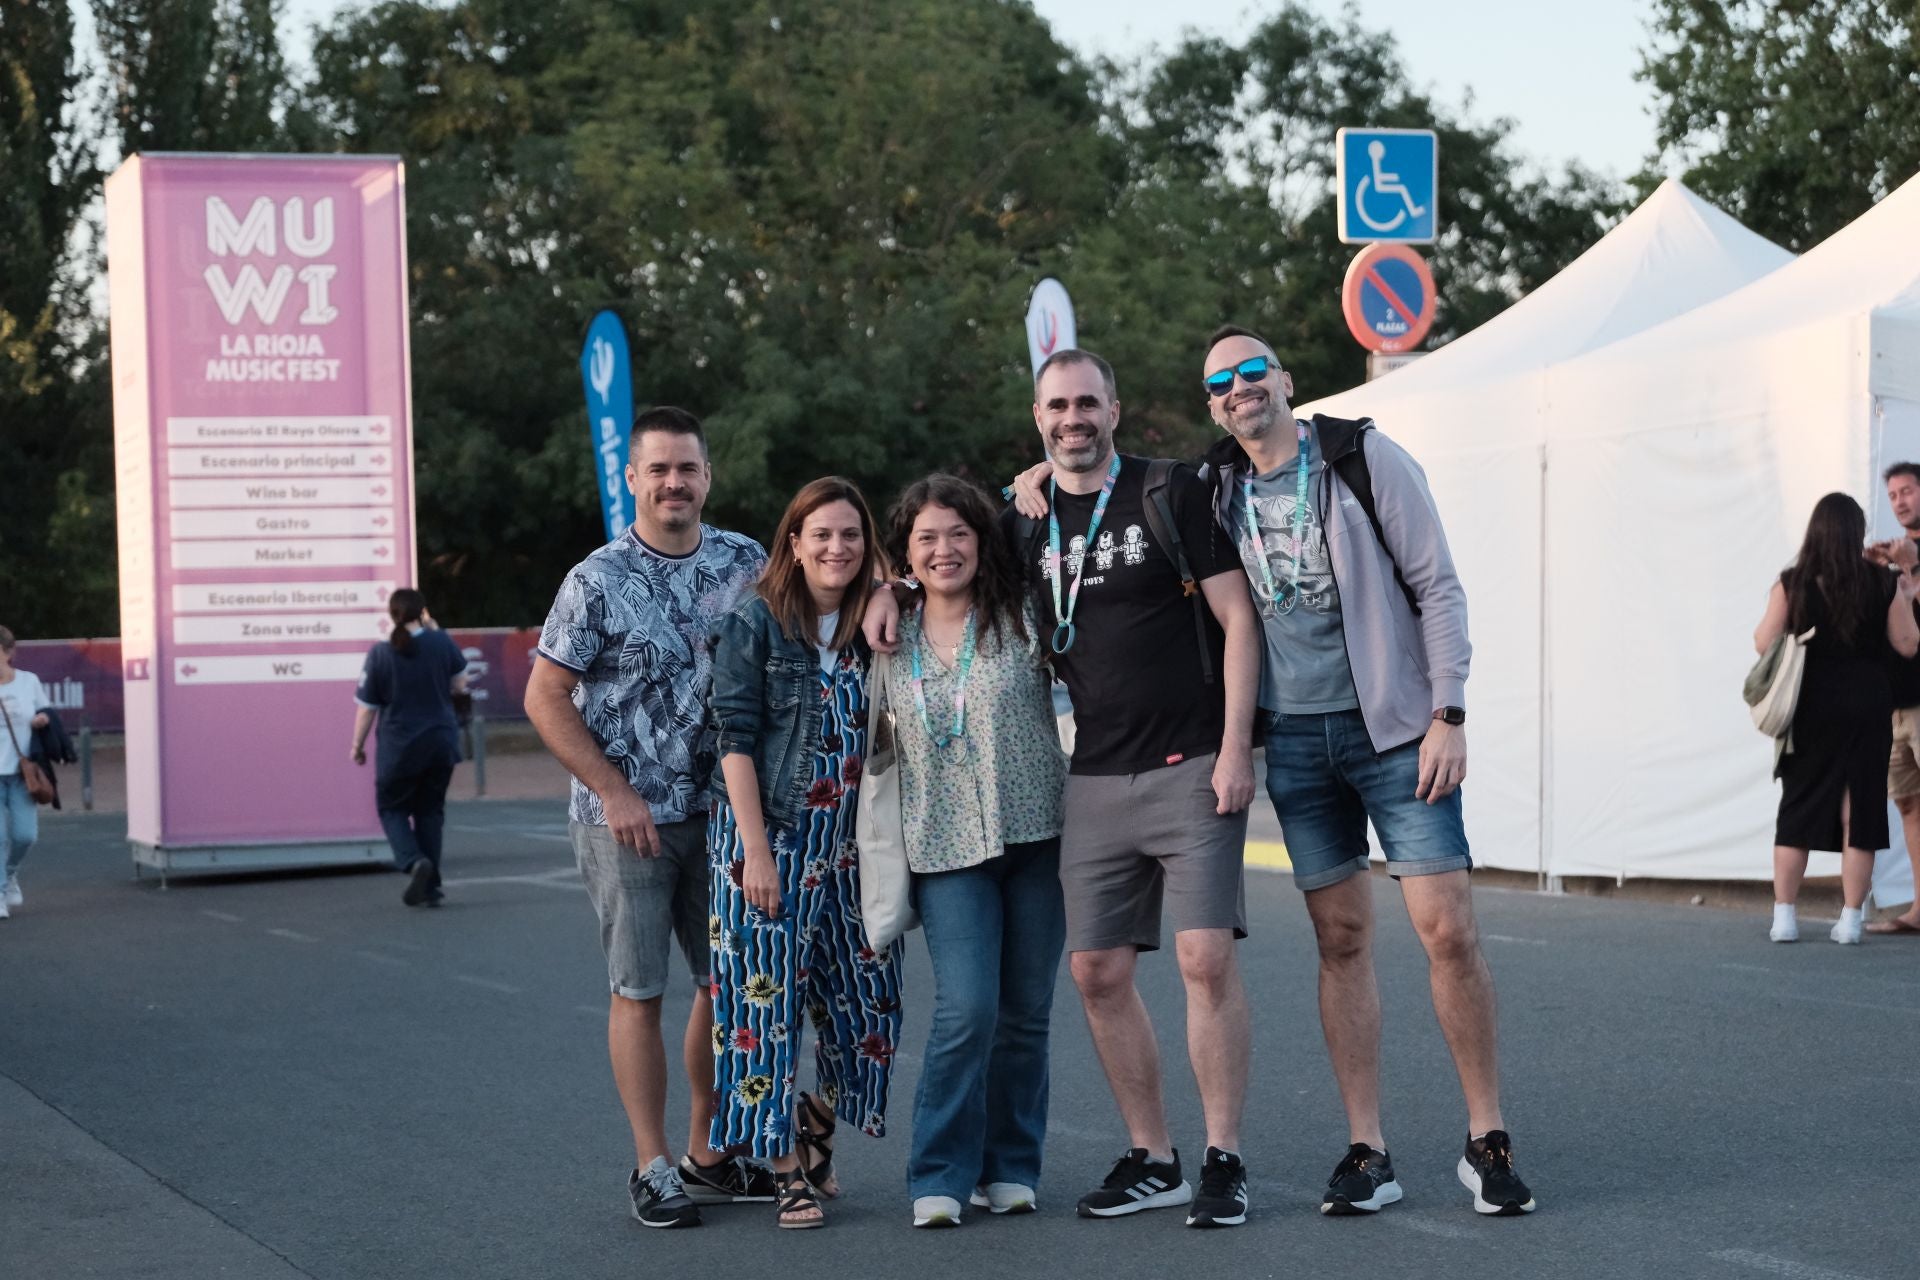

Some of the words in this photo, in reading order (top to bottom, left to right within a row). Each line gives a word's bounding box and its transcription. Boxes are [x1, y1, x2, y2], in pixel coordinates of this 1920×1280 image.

[205, 195, 335, 258] MU
[220, 334, 253, 356] LA
[254, 334, 325, 357] RIOJA
[197, 425, 262, 437] Escenario
[201, 454, 280, 468] Escenario
[284, 453, 355, 469] principal
[246, 486, 287, 499] Wine
[291, 485, 318, 498] bar
[256, 516, 310, 531] Gastro
[255, 548, 313, 561] Market
[208, 590, 288, 605] Escenario
[291, 588, 358, 607] Ibercaja
[241, 623, 282, 636] Zona
[287, 620, 331, 634] verde
[272, 662, 302, 676] WC
